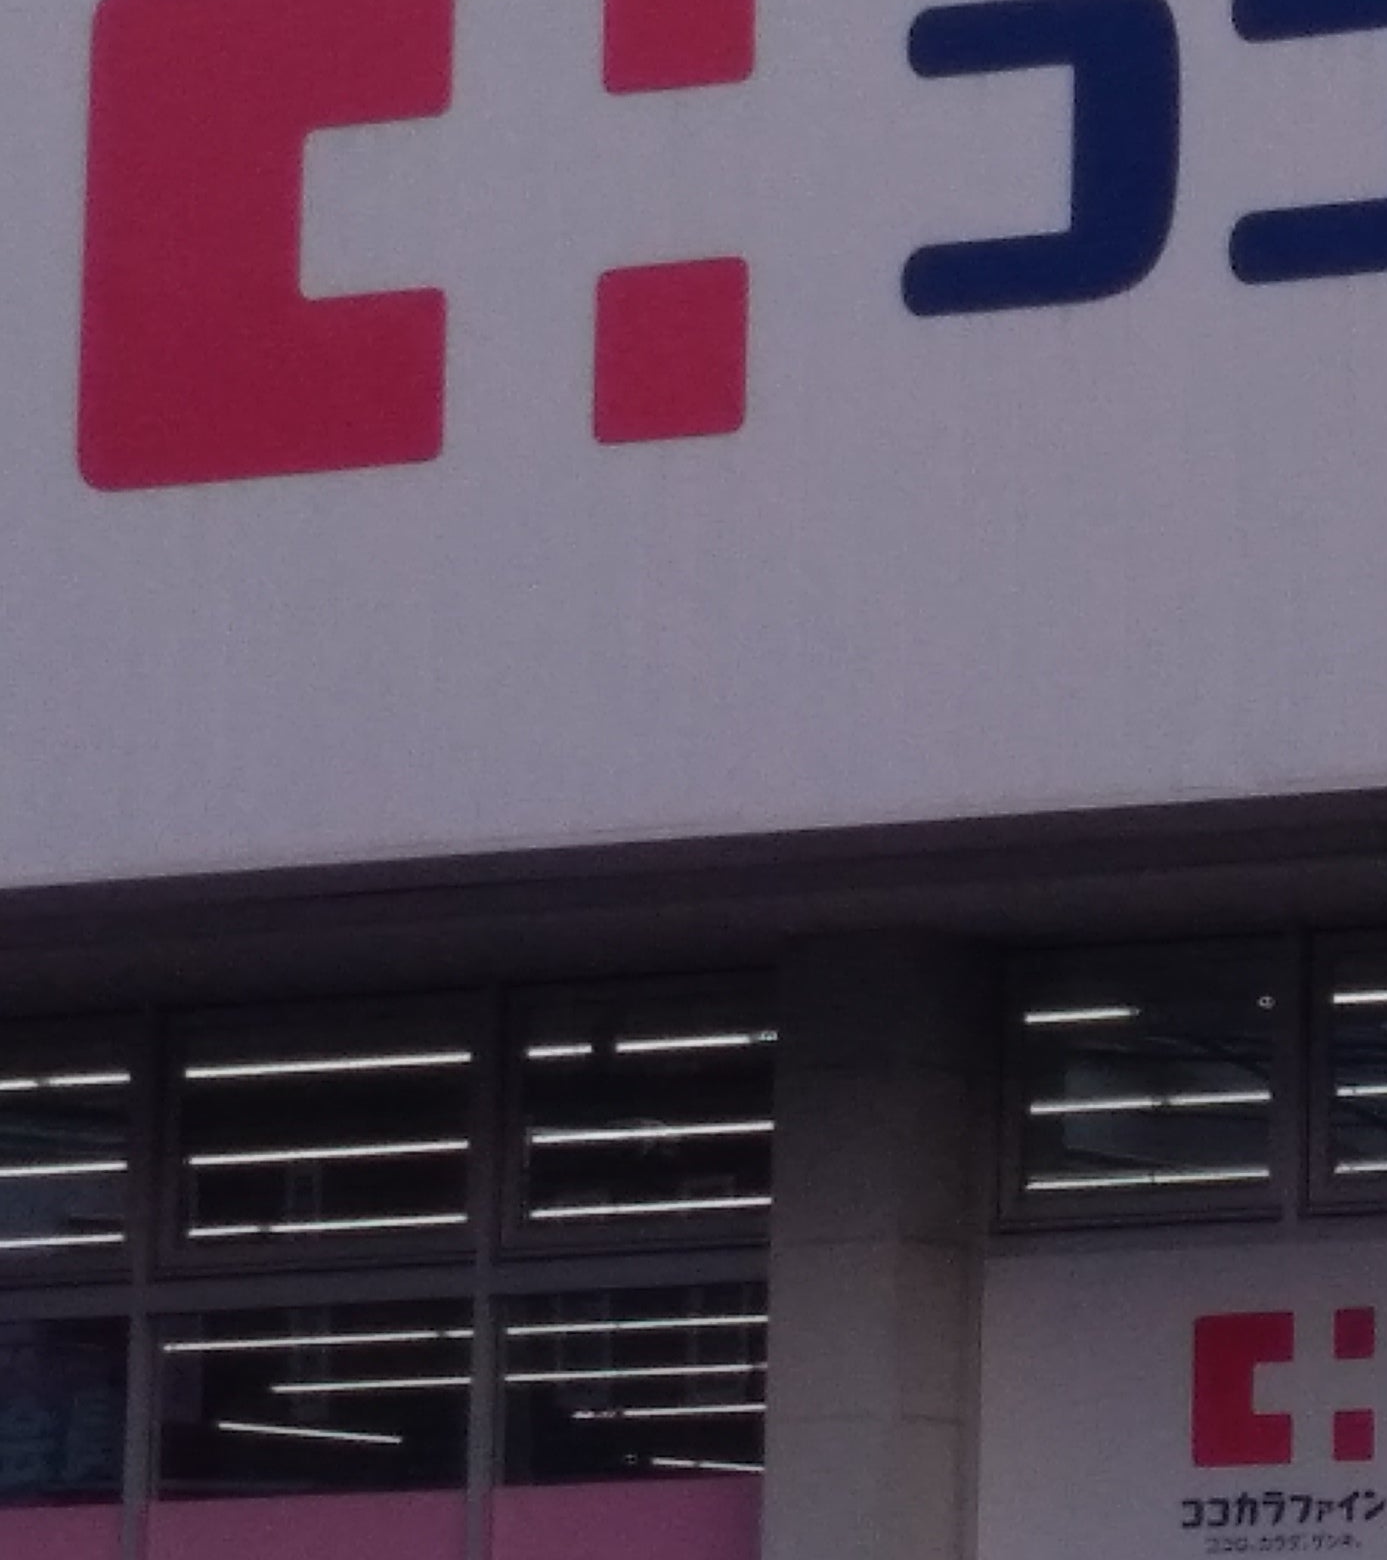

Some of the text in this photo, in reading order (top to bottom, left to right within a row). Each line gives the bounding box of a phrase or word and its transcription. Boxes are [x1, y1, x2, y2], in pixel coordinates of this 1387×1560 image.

[1181, 1489, 1387, 1529] ココカラファイン
